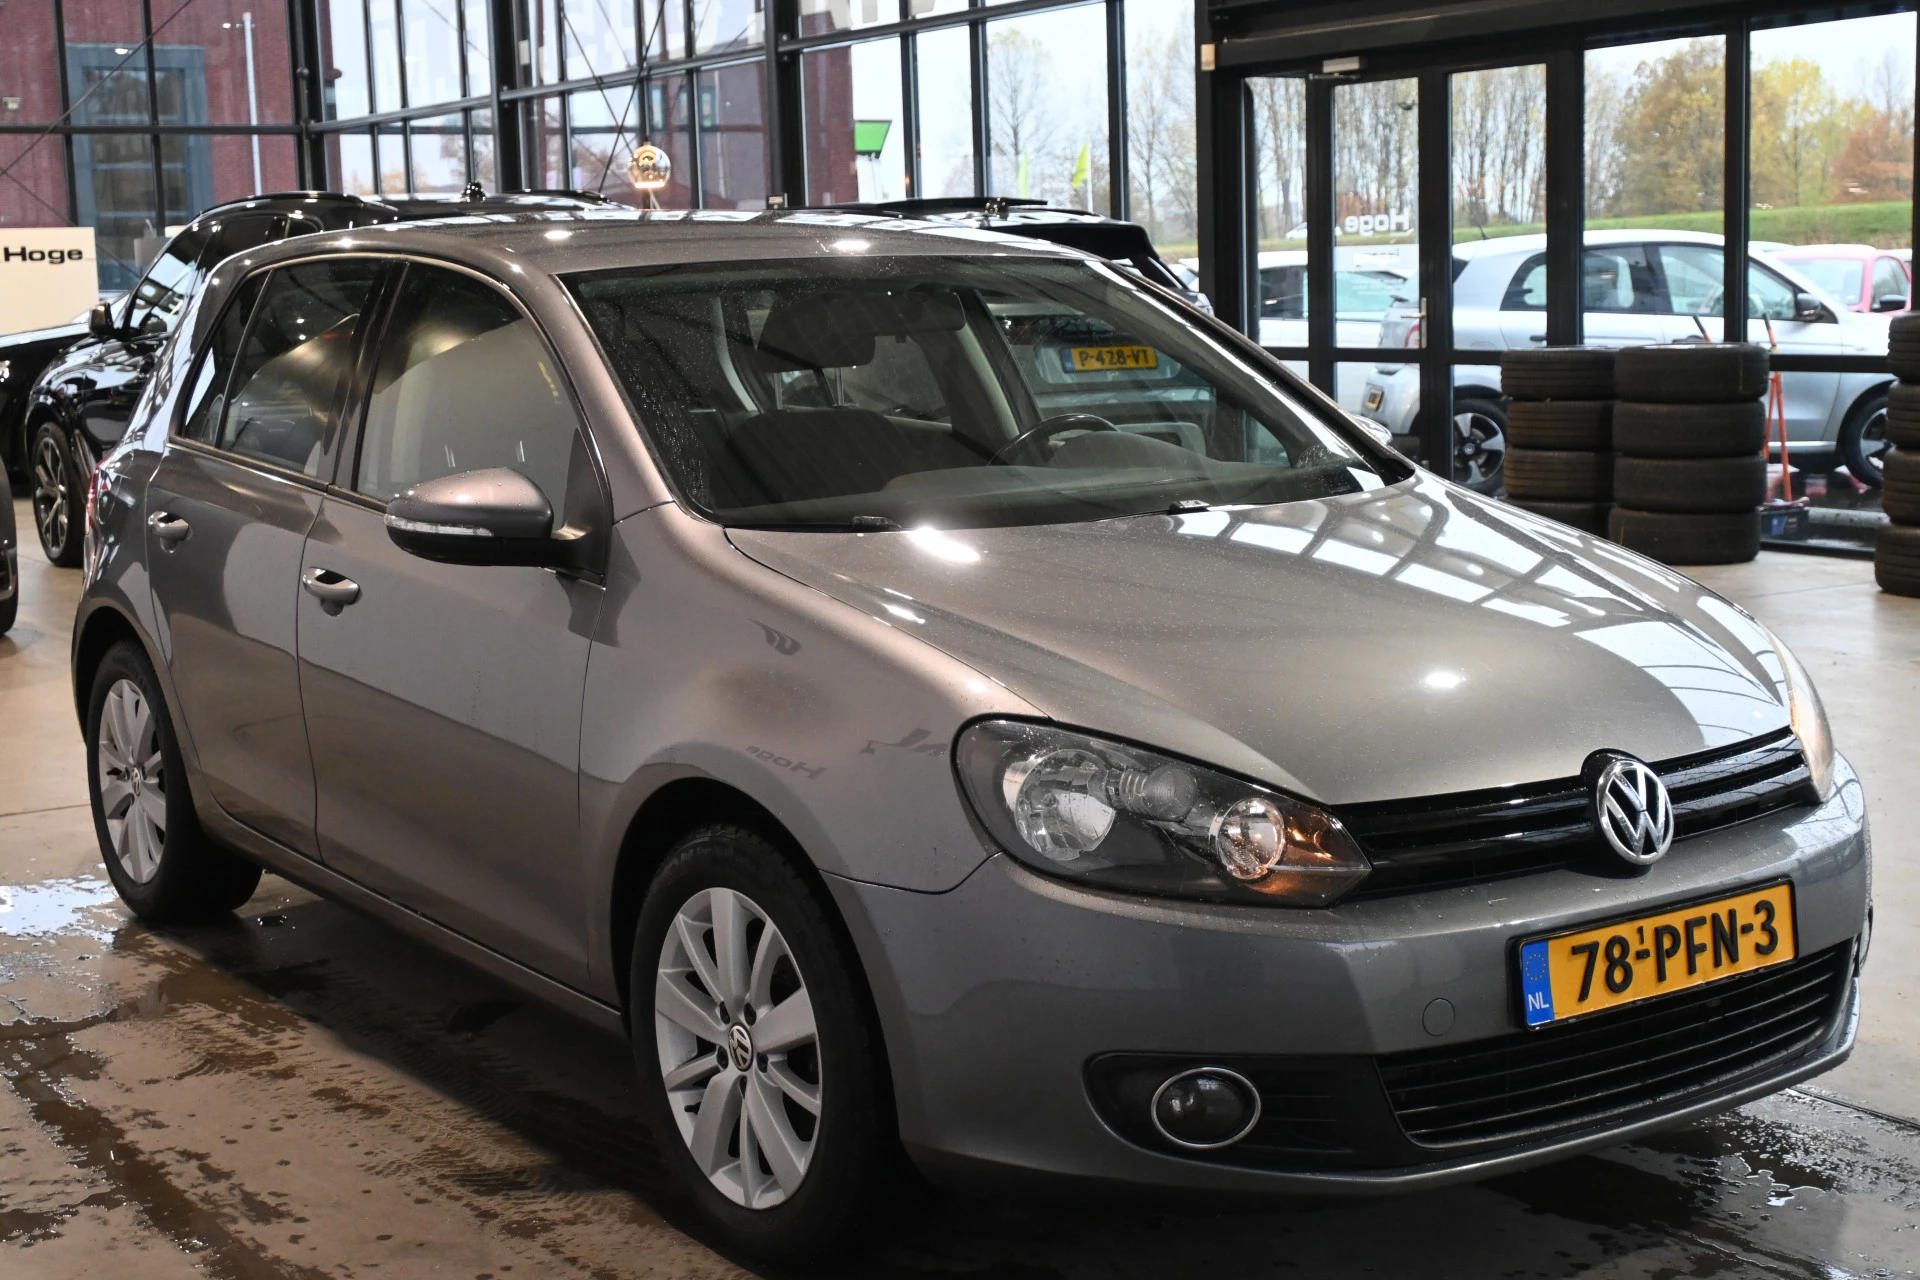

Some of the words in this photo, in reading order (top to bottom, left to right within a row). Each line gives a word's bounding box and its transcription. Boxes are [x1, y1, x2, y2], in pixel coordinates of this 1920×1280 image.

[3, 246, 84, 265] Hoge
[1597, 760, 1674, 865] VW
[1528, 991, 1550, 1012] NL
